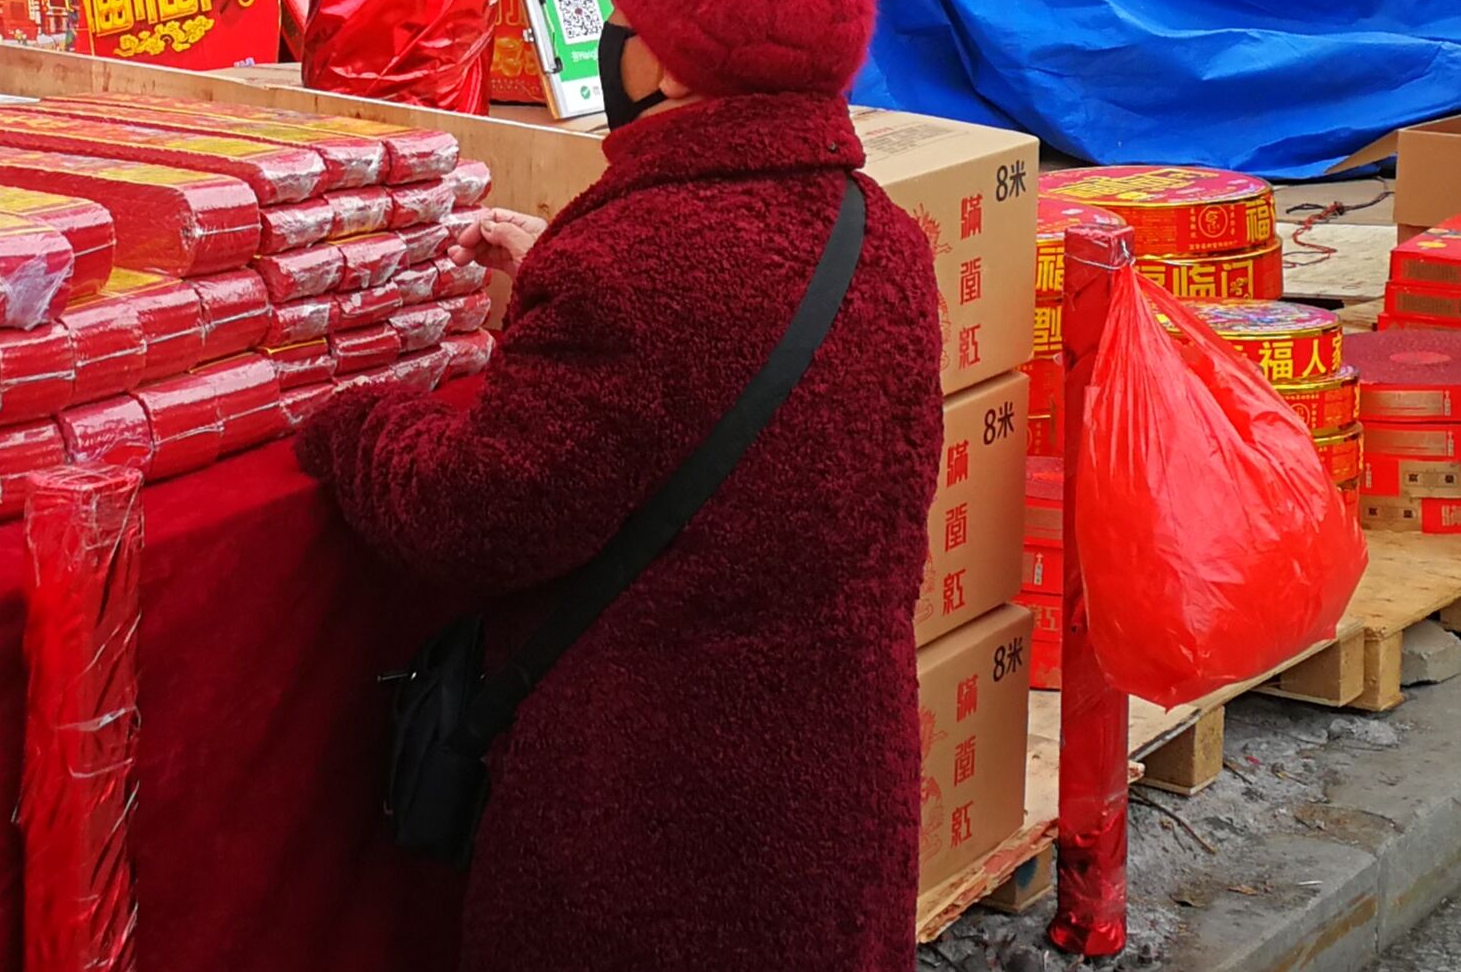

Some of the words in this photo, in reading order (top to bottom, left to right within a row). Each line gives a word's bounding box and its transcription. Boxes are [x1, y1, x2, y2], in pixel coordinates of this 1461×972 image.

[995, 159, 1026, 202] 8米
[983, 401, 1014, 445] 8米
[993, 636, 1023, 682] 8米
